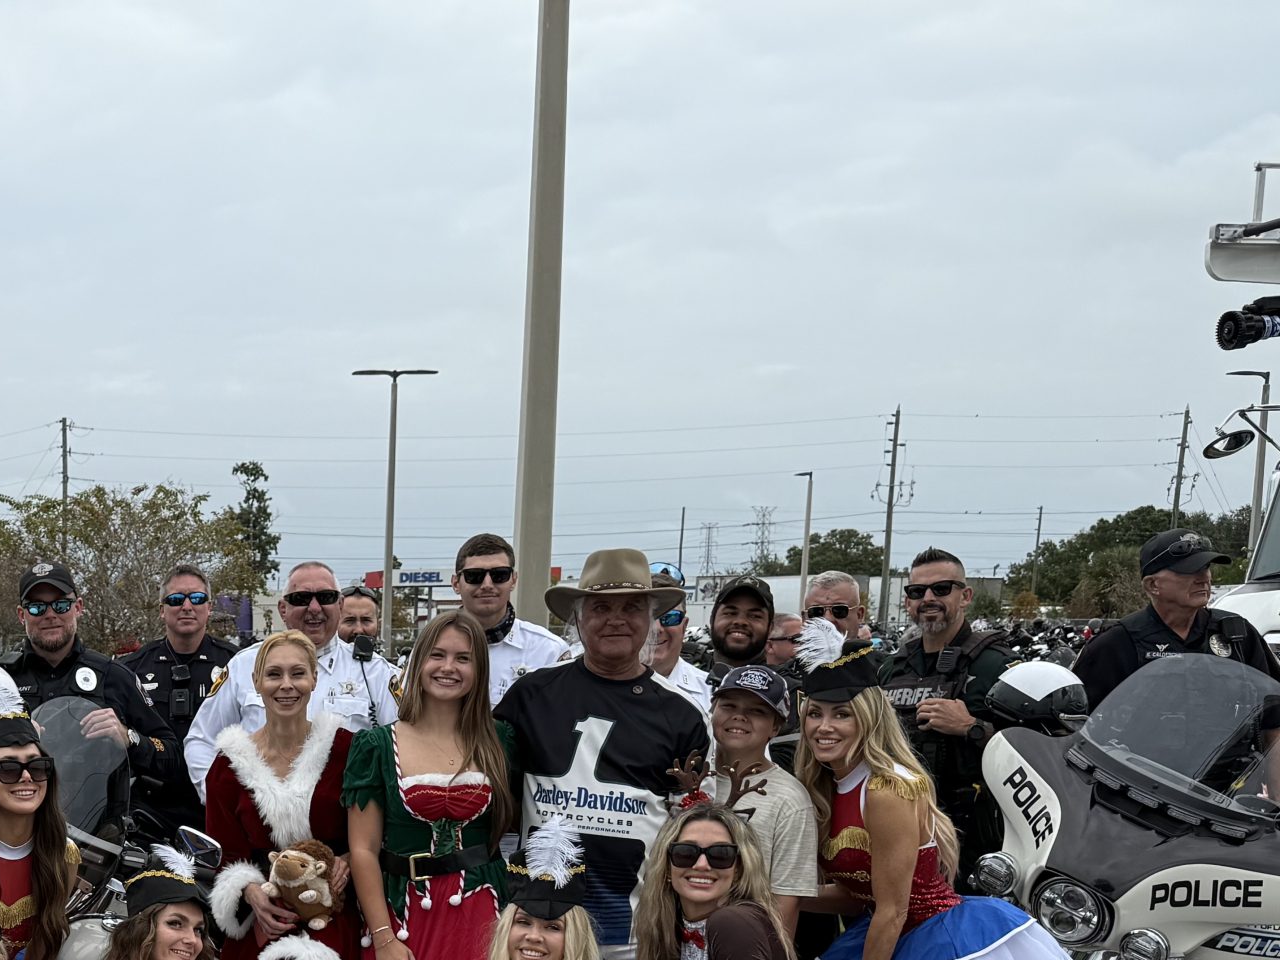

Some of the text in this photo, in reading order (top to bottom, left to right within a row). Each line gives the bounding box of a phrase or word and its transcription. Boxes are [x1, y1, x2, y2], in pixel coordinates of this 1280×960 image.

[399, 572, 443, 583] DIESEL
[533, 783, 648, 815] Harley-Davidson
[1002, 765, 1054, 850] POLICE
[577, 825, 630, 834] PERFORMANCE
[1149, 879, 1264, 911] POLICE
[1216, 933, 1280, 957] POLIC
